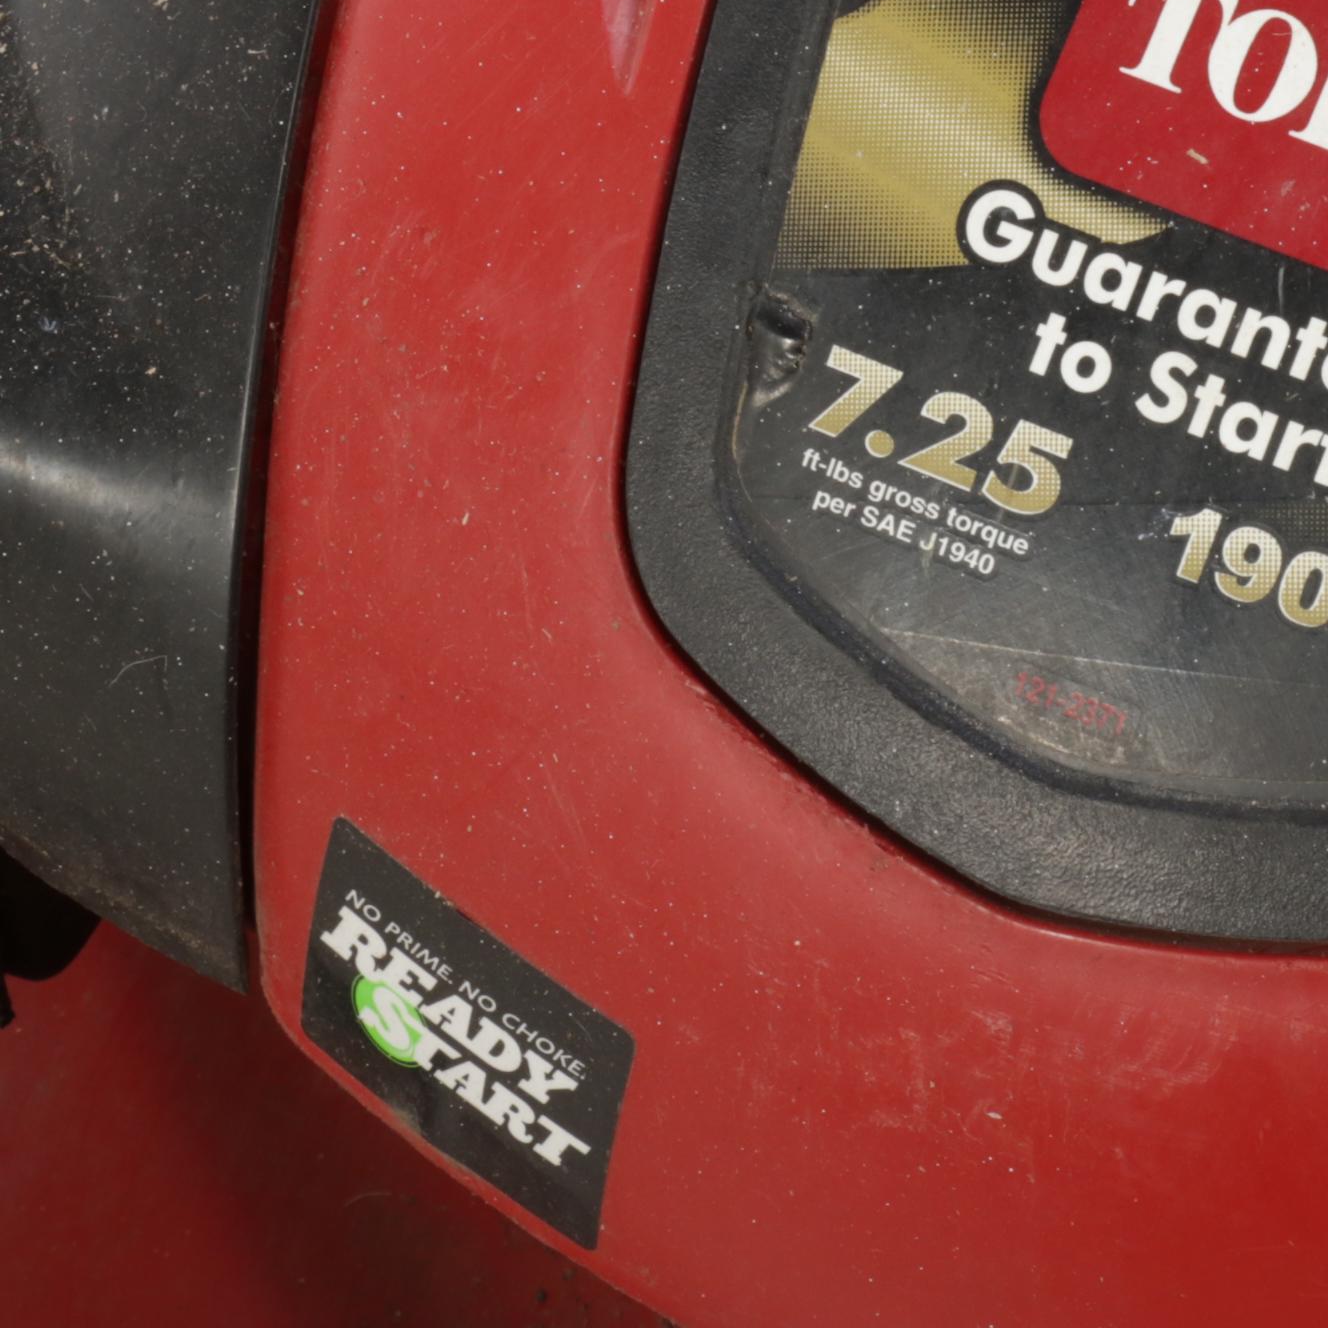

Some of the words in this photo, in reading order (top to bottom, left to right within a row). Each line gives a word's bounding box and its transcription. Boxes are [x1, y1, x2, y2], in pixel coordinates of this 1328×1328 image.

[808, 343, 1074, 515] 7.25
[1029, 312, 1112, 394] to
[801, 448, 864, 489] ft-lbs
[867, 479, 941, 520] gross
[945, 506, 1030, 557] torque
[811, 490, 857, 518] per
[860, 504, 917, 544] SAE
[918, 531, 996, 576] J1940
[320, 905, 579, 1105] READY
[345, 889, 382, 922] NO
[385, 921, 454, 985] PRIME.
[459, 980, 497, 1013] NO
[502, 1013, 586, 1080] CHOKE.
[356, 985, 592, 1166] START
